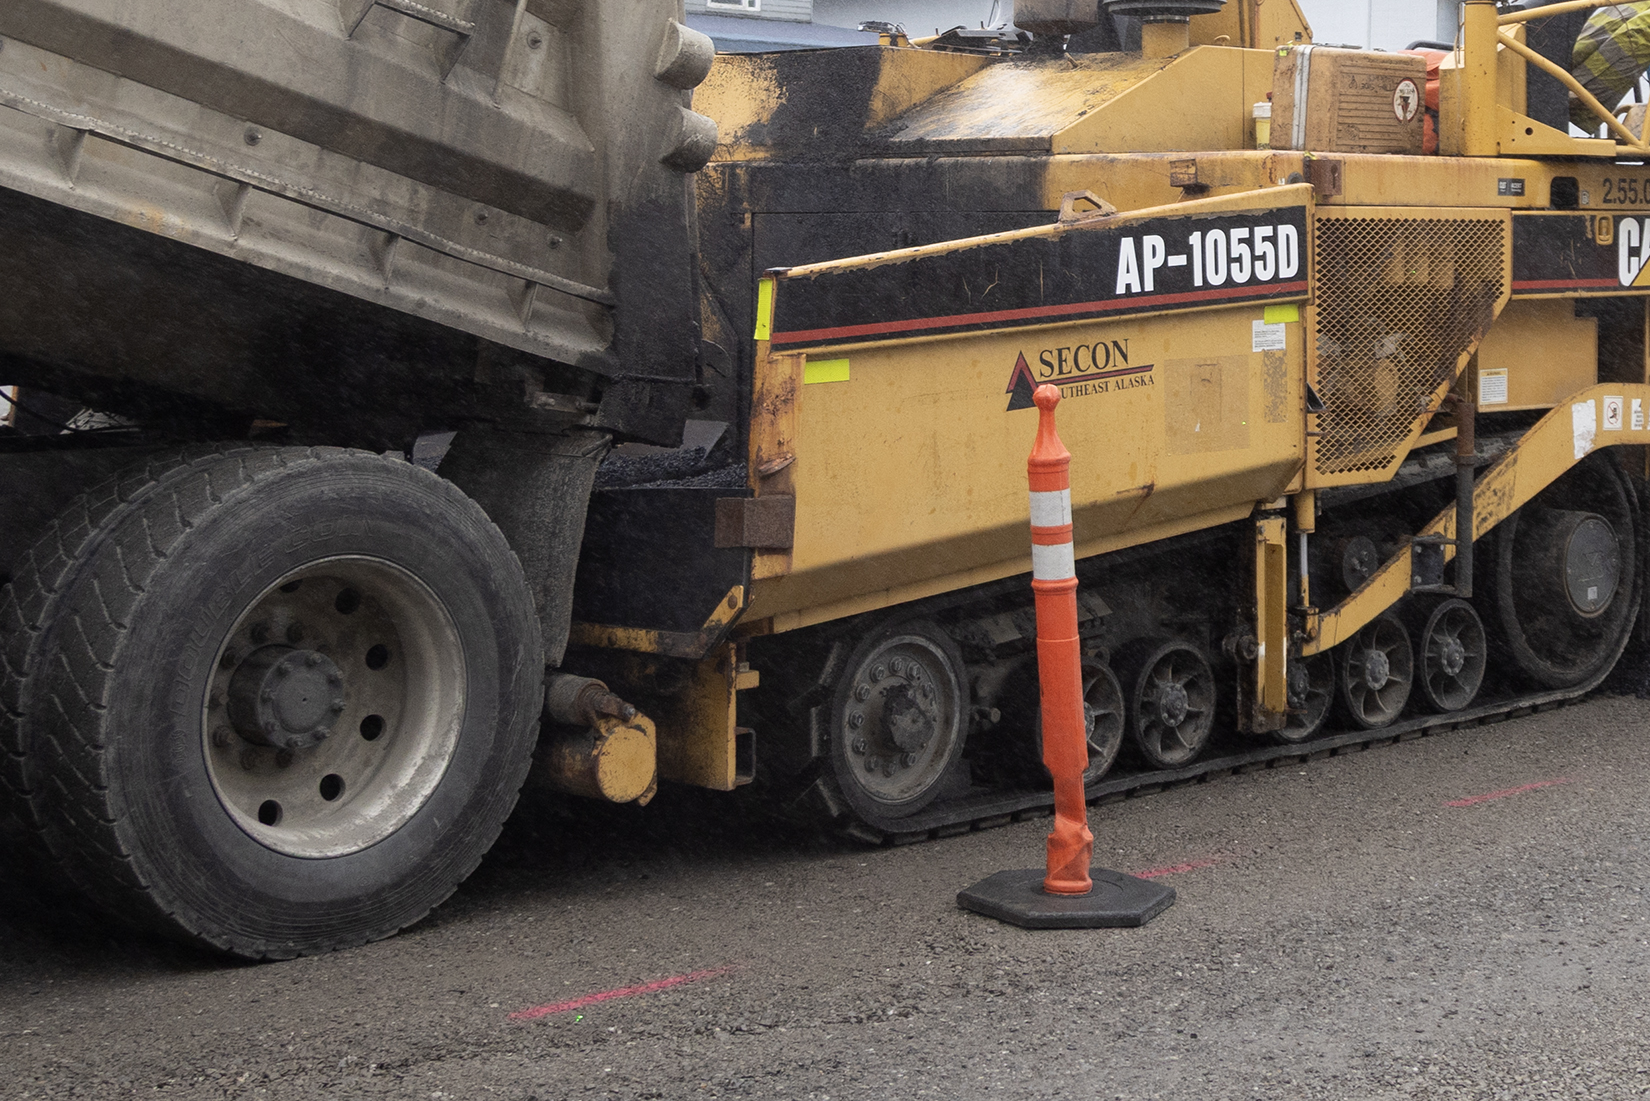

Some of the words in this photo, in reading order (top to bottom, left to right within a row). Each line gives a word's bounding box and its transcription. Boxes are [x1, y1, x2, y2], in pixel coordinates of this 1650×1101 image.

[1115, 224, 1300, 295] AP-1055D
[1038, 338, 1130, 379] SECON
[1061, 382, 1111, 400] UTHEAST
[1113, 375, 1155, 392] ALASKA
